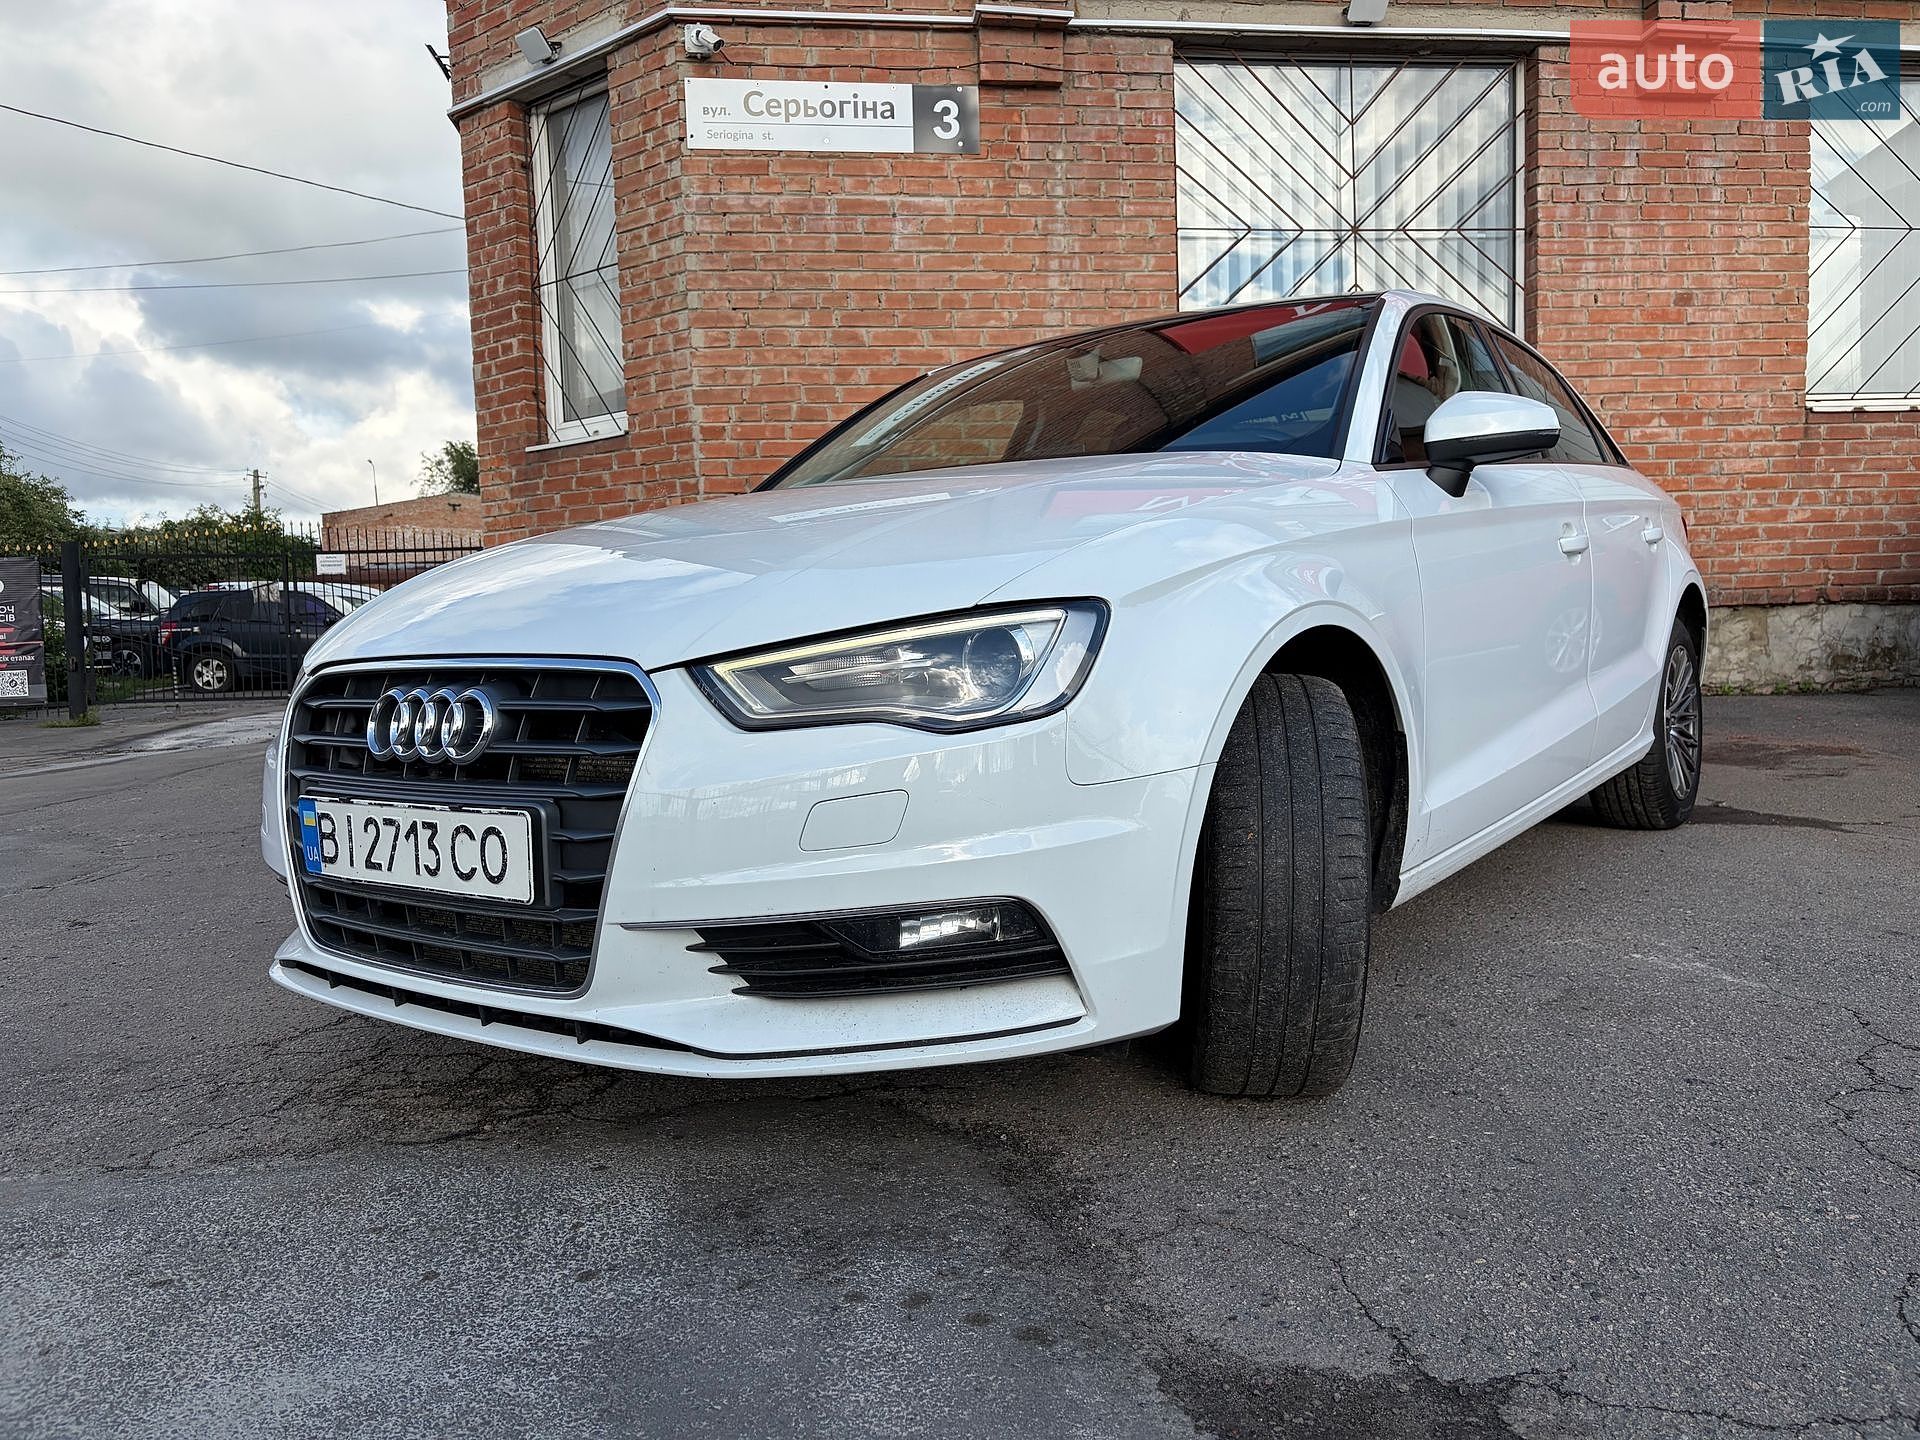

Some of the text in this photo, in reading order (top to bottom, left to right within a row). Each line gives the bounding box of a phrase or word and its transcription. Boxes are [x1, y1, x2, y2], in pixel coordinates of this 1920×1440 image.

[702, 90, 895, 123] вул. Серьогіна
[932, 99, 960, 140] 3
[706, 128, 774, 143] Seriogina st.
[307, 845, 320, 862] UA
